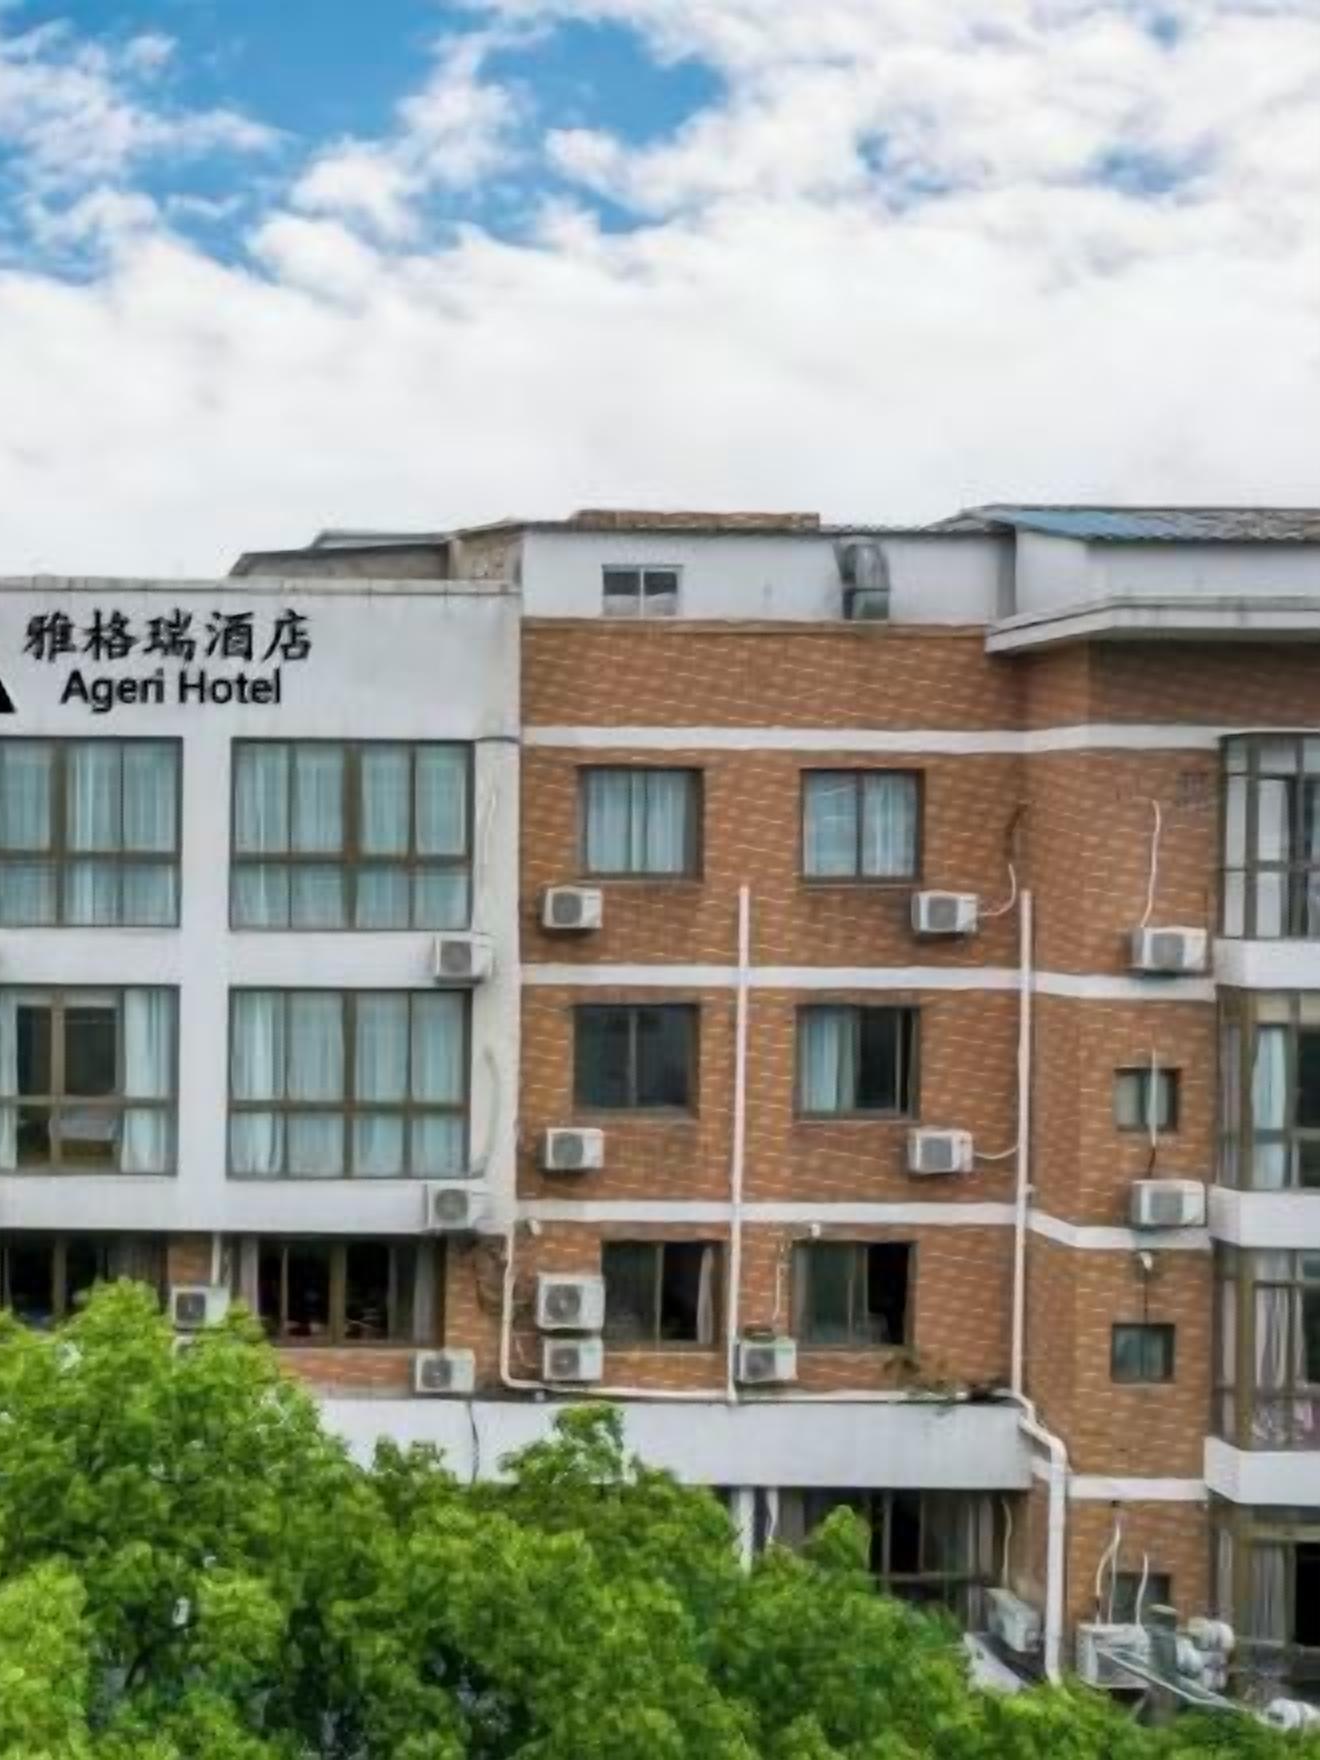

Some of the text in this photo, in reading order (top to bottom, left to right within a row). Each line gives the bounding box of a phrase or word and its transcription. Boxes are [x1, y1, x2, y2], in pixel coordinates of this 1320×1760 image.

[23, 608, 312, 662] 雅格瑞酒店
[60, 668, 282, 713] Ageri Hotel
